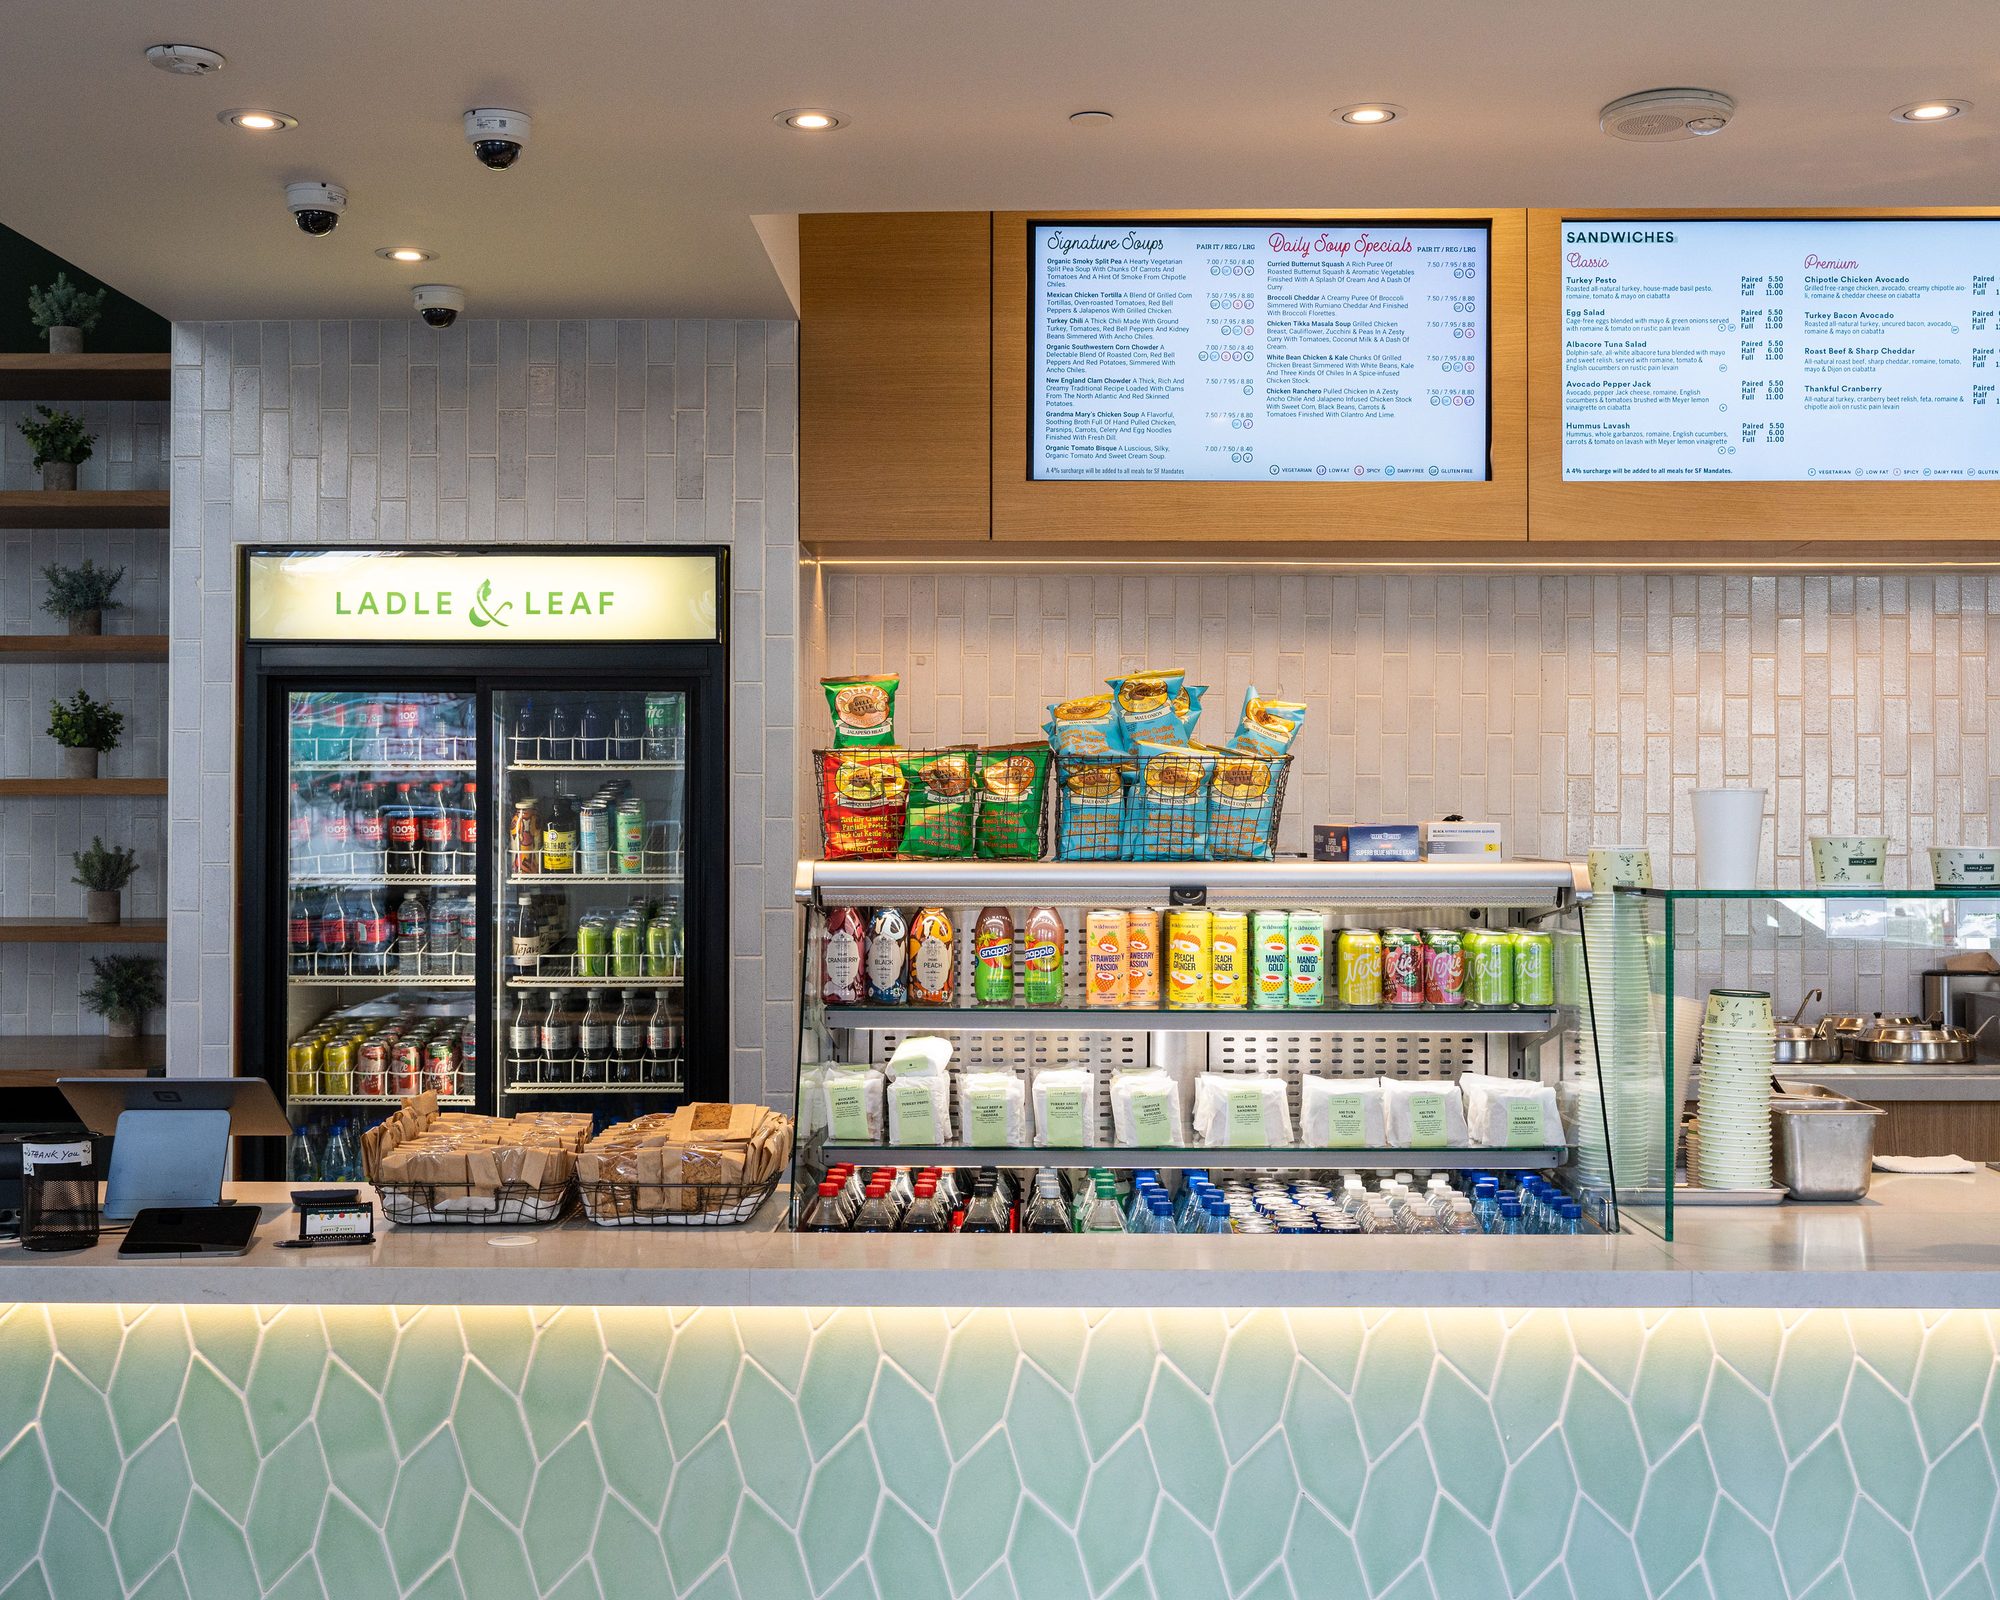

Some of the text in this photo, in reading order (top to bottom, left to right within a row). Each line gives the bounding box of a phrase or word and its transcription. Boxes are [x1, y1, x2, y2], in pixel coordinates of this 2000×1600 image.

[1047, 231, 1164, 255] Signature Soups
[1567, 232, 1675, 243] SANDWICHES
[1268, 232, 1412, 258] Daily Soup Specials
[1567, 252, 1609, 268] Classic
[1804, 254, 1859, 270] Premium
[1805, 276, 1838, 284] Chipotle
[1566, 309, 1581, 317] Egg
[336, 578, 614, 627] LADLE & LEAF
[392, 825, 415, 834] 100%
[1026, 946, 1054, 958] napple
[1130, 960, 1148, 968] ASSION
[1215, 955, 1232, 963] PEACH
[1344, 954, 1380, 984] Nixie
[1426, 952, 1462, 982] Nixie
[31, 1150, 58, 1159] THANK
